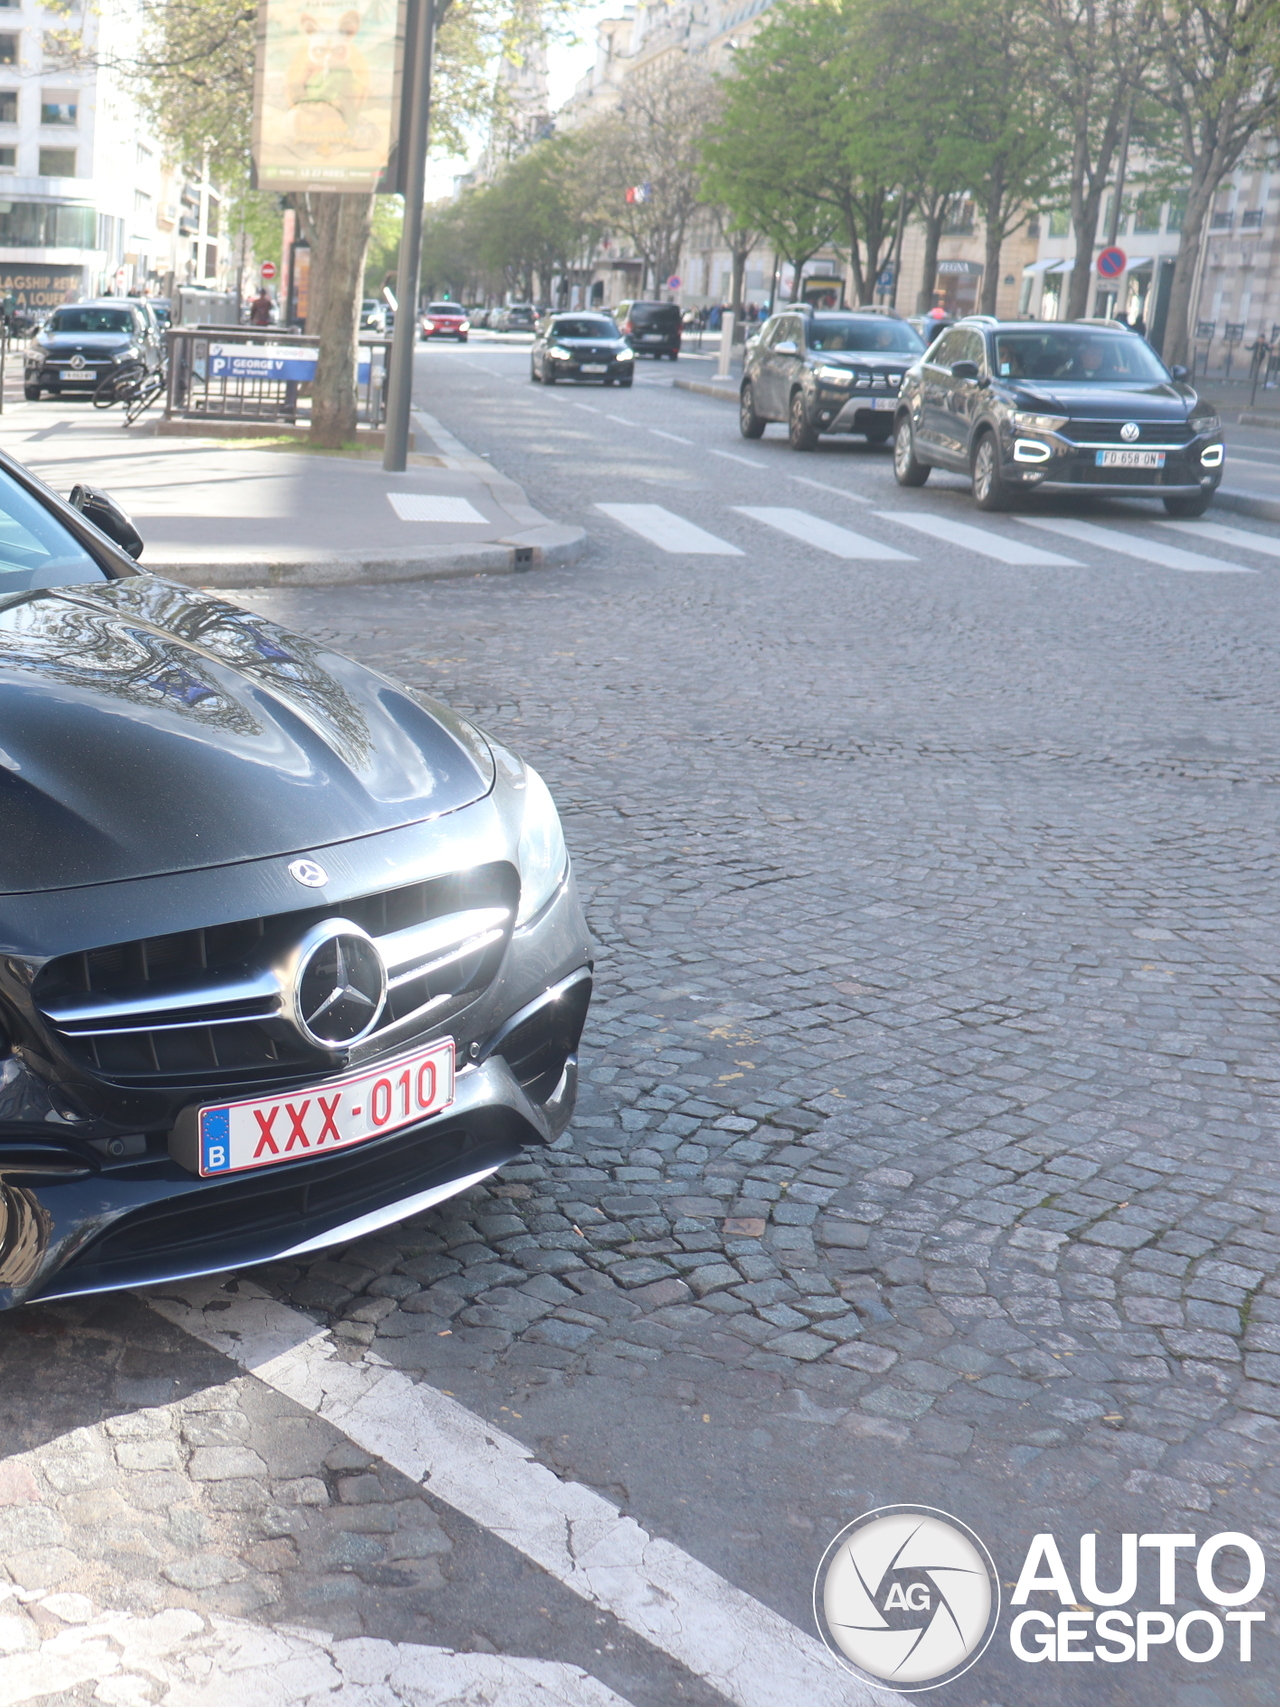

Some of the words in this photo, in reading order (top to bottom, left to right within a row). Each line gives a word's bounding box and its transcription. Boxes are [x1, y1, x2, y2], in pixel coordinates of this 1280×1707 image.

[938, 261, 969, 273] ZEGNA
[16, 293, 26, 305] A
[233, 358, 274, 370] GEORGE
[275, 360, 284, 370] V
[252, 1060, 436, 1158] XXX-010
[209, 1146, 225, 1167] B
